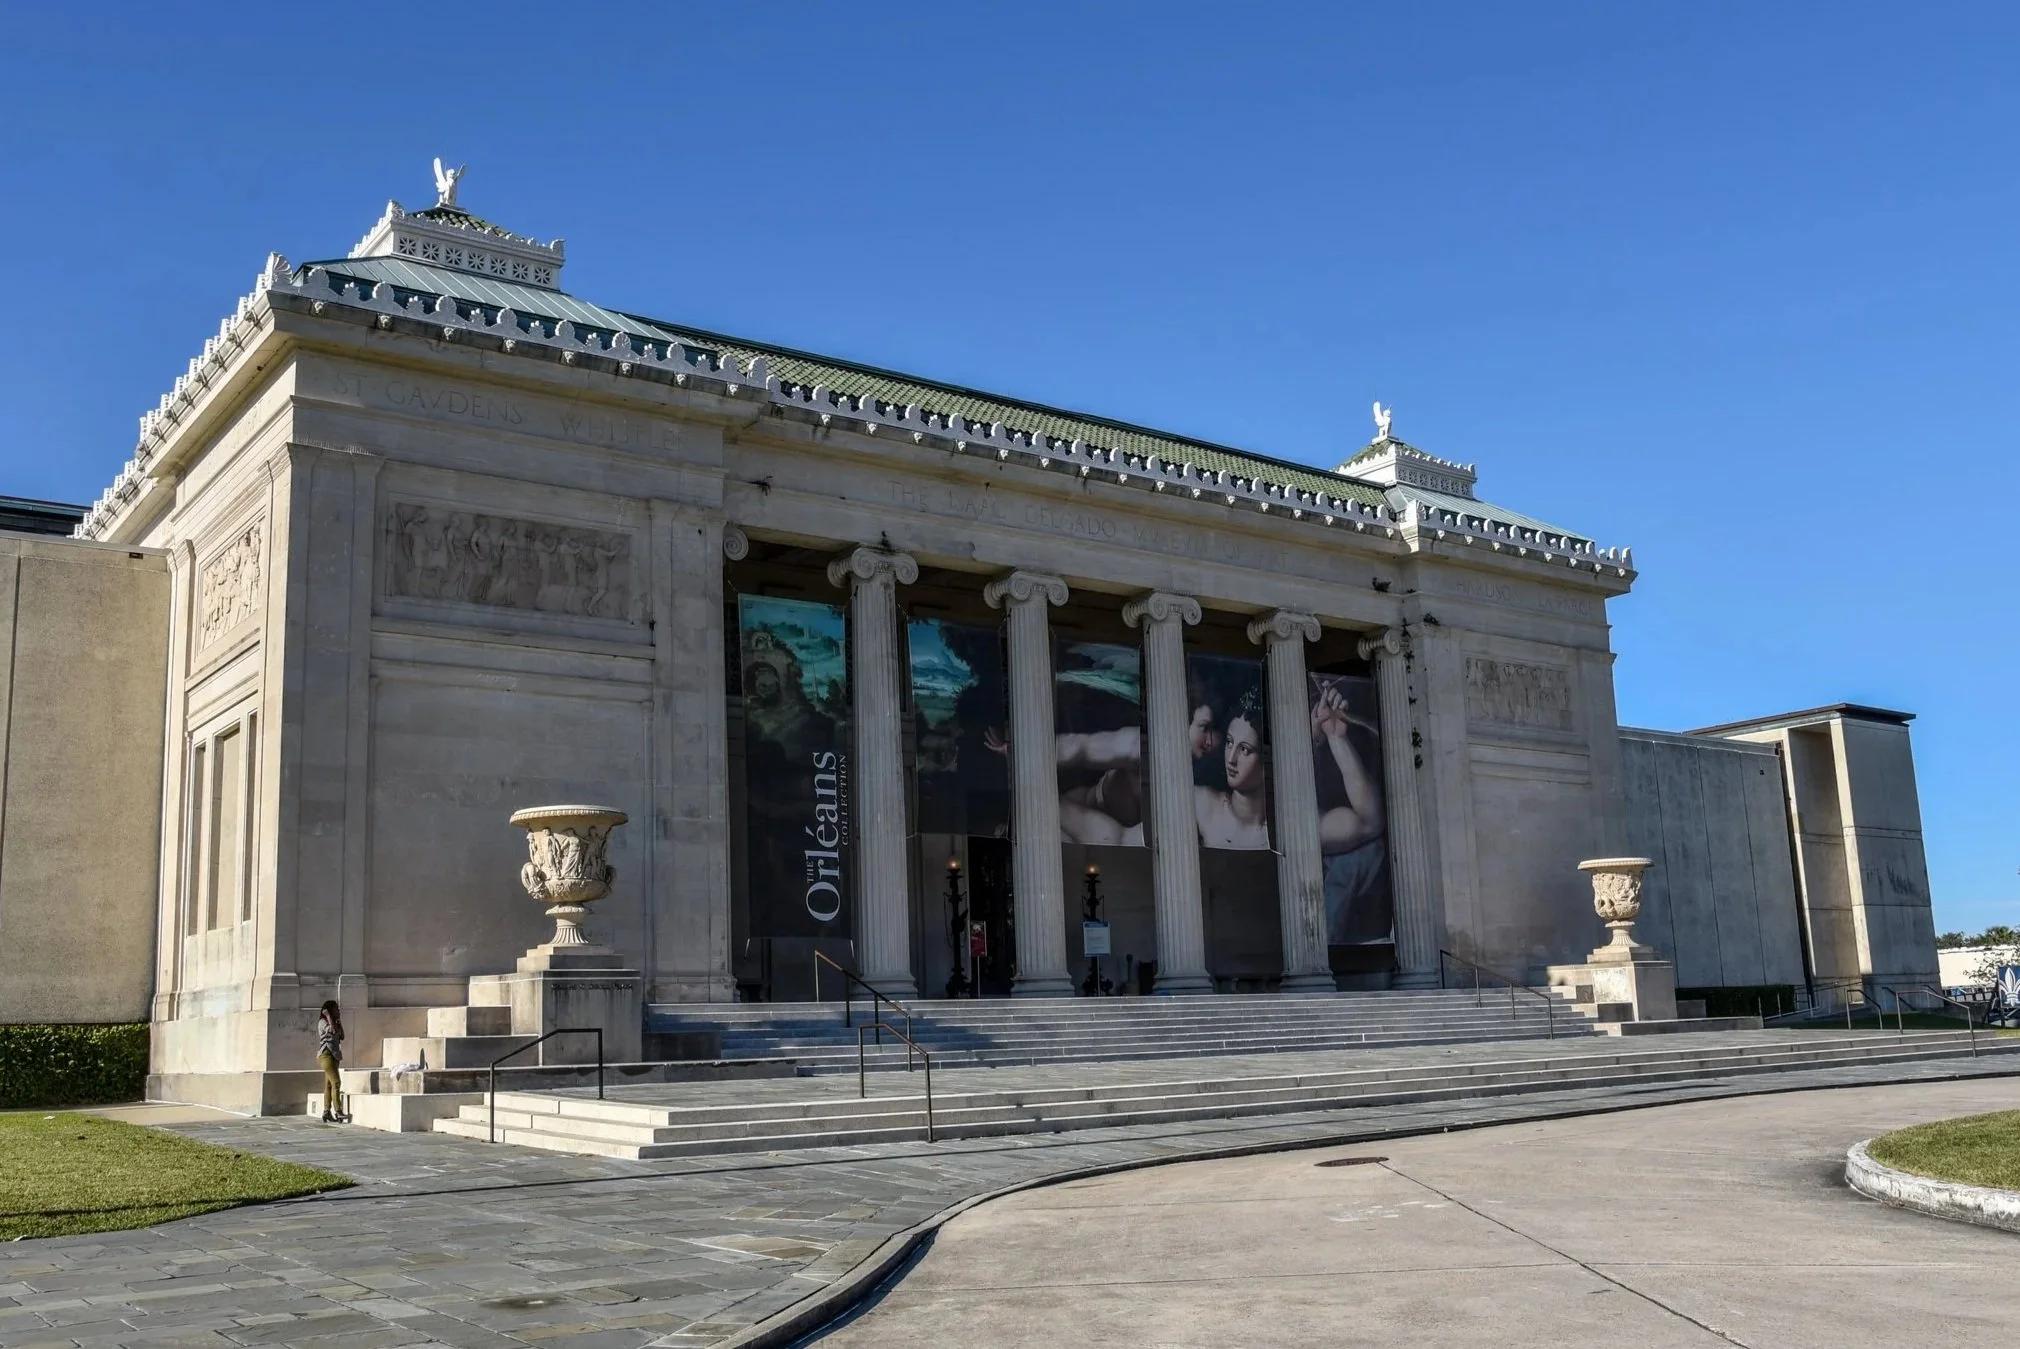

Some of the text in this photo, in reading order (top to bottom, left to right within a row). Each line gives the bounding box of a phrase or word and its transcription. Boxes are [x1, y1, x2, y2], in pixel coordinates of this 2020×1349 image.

[886, 479, 929, 507] THE
[1025, 504, 1117, 538] DELGADO
[805, 751, 841, 922] Orléans
[840, 754, 850, 846] COLLECTION
[807, 860, 815, 883] THE
